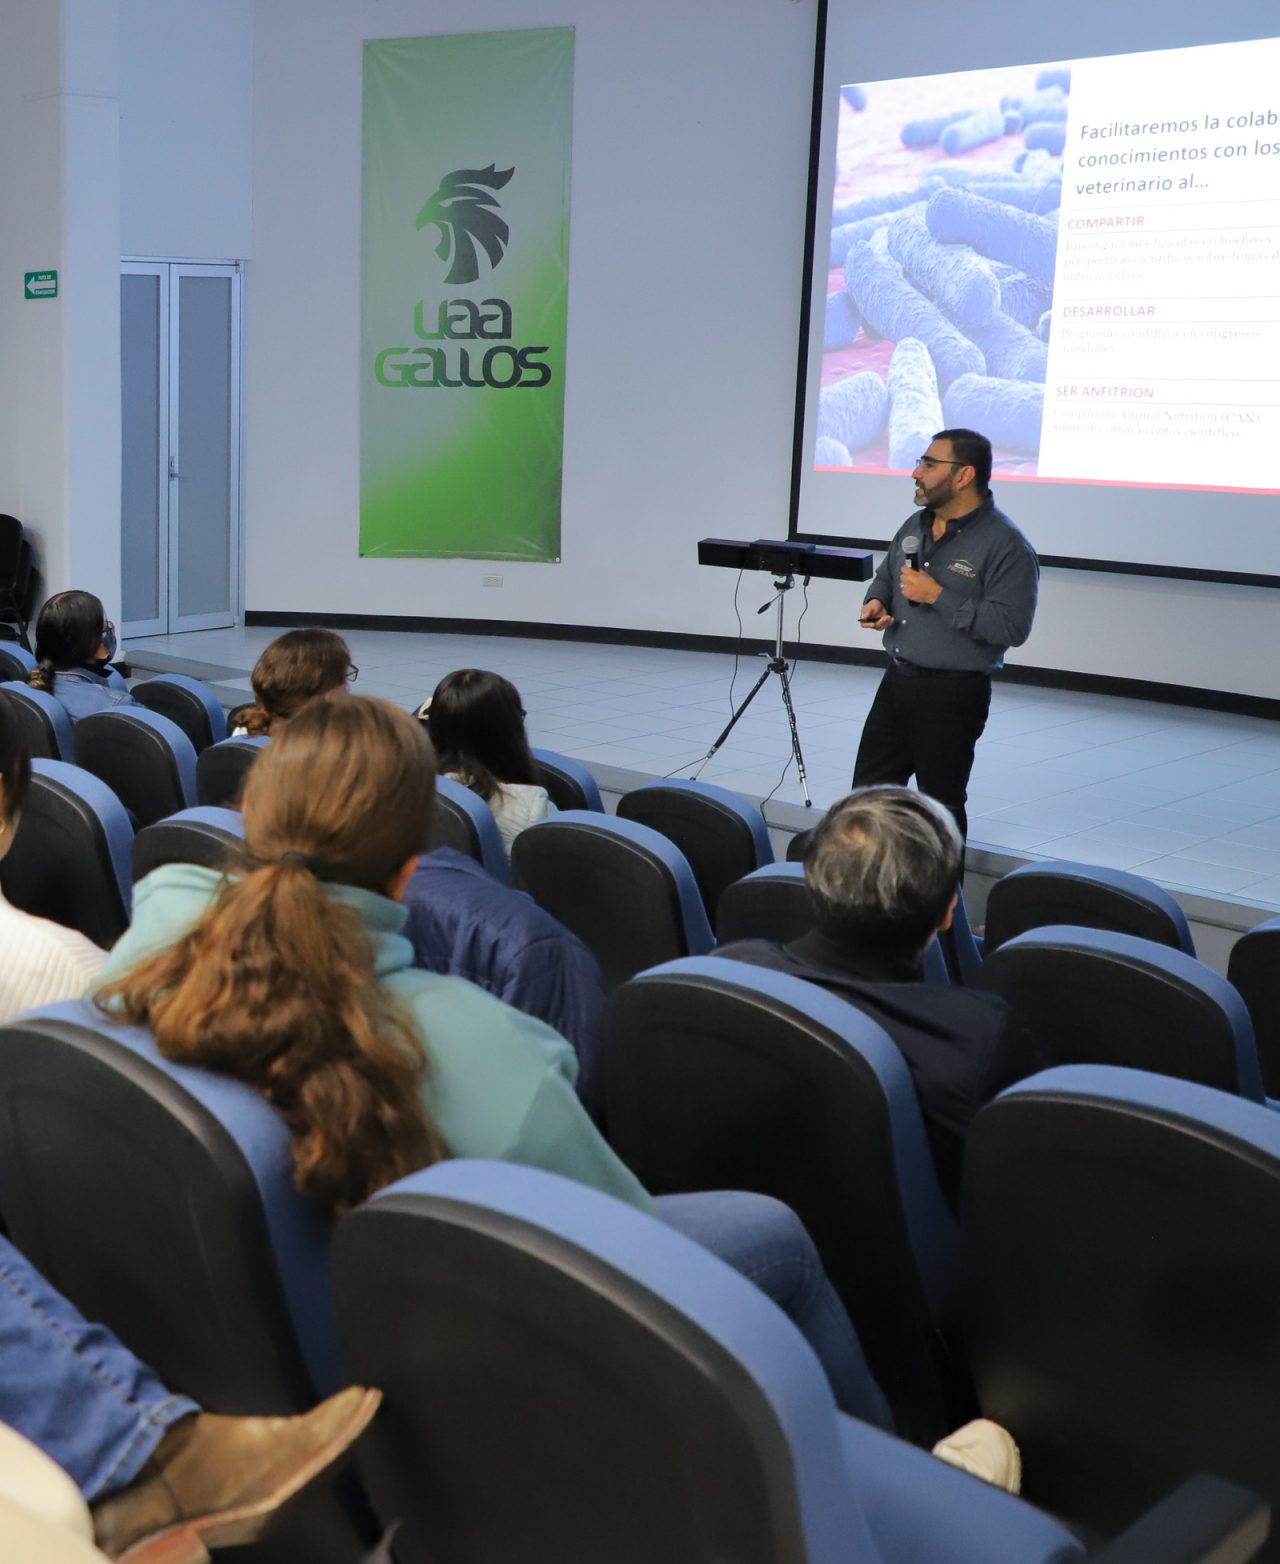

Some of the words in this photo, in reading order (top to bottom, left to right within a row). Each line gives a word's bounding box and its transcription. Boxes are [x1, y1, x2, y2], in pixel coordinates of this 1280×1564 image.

[1080, 118, 1198, 140] Facilitaremos
[1205, 114, 1220, 130] la
[1227, 109, 1280, 129] colab
[1077, 146, 1208, 168] conocimientos
[1214, 144, 1247, 158] con
[1254, 139, 1280, 156] los
[1076, 176, 1173, 195] veterinario
[1178, 173, 1209, 190] al...
[1067, 215, 1145, 230] COMPARTIR
[1062, 304, 1156, 318] DESARROLLAR
[1055, 386, 1078, 397] SER
